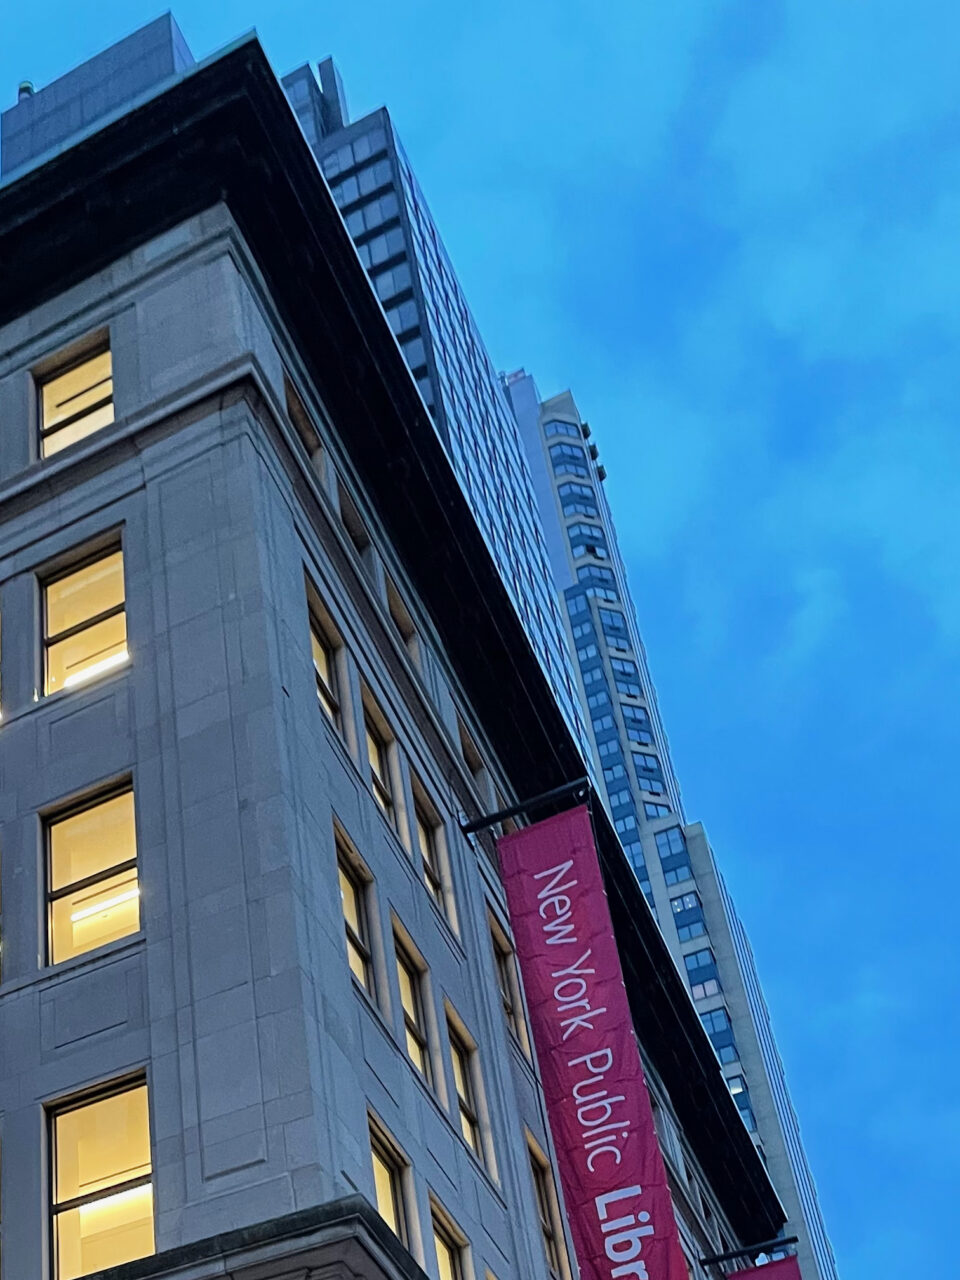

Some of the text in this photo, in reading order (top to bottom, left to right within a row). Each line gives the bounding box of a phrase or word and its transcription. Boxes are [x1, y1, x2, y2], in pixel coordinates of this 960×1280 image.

[534, 859, 578, 945] New
[551, 948, 607, 1041] York
[567, 1047, 631, 1172] Public
